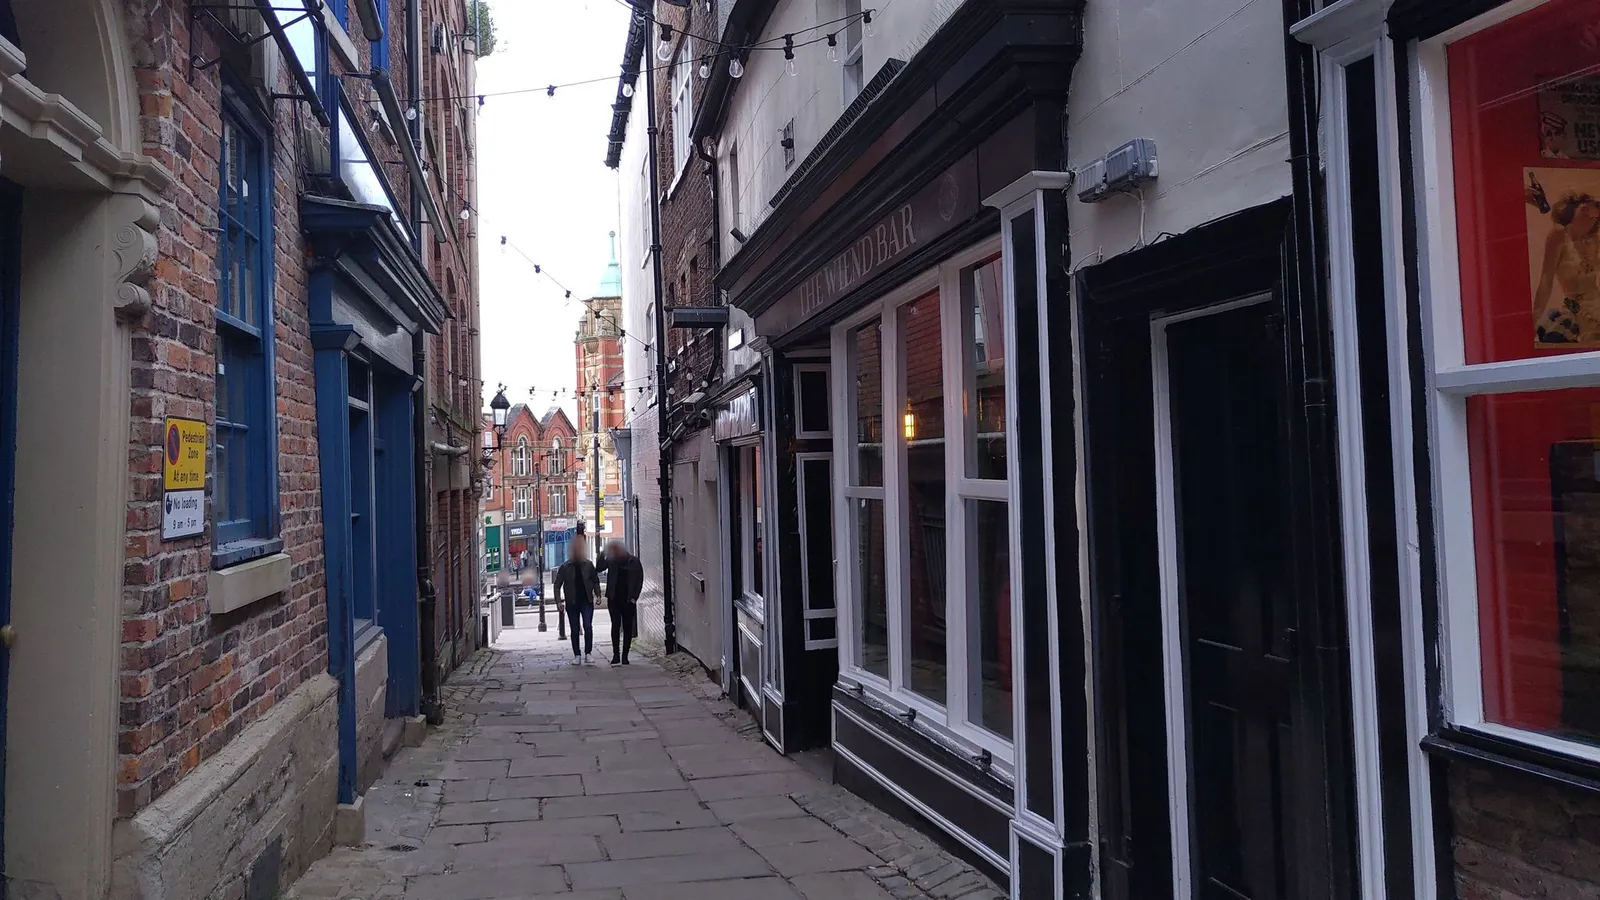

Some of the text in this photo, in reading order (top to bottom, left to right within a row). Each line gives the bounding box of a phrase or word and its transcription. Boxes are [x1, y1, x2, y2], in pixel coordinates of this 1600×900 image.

[797, 203, 917, 317] THE WIEND BAR
[182, 430, 205, 444] Pedestrian
[188, 446, 199, 459] Zone
[173, 469, 199, 484] At any time
[173, 496, 198, 510] No loading
[177, 521, 183, 529] am
[191, 519, 197, 528] pm
